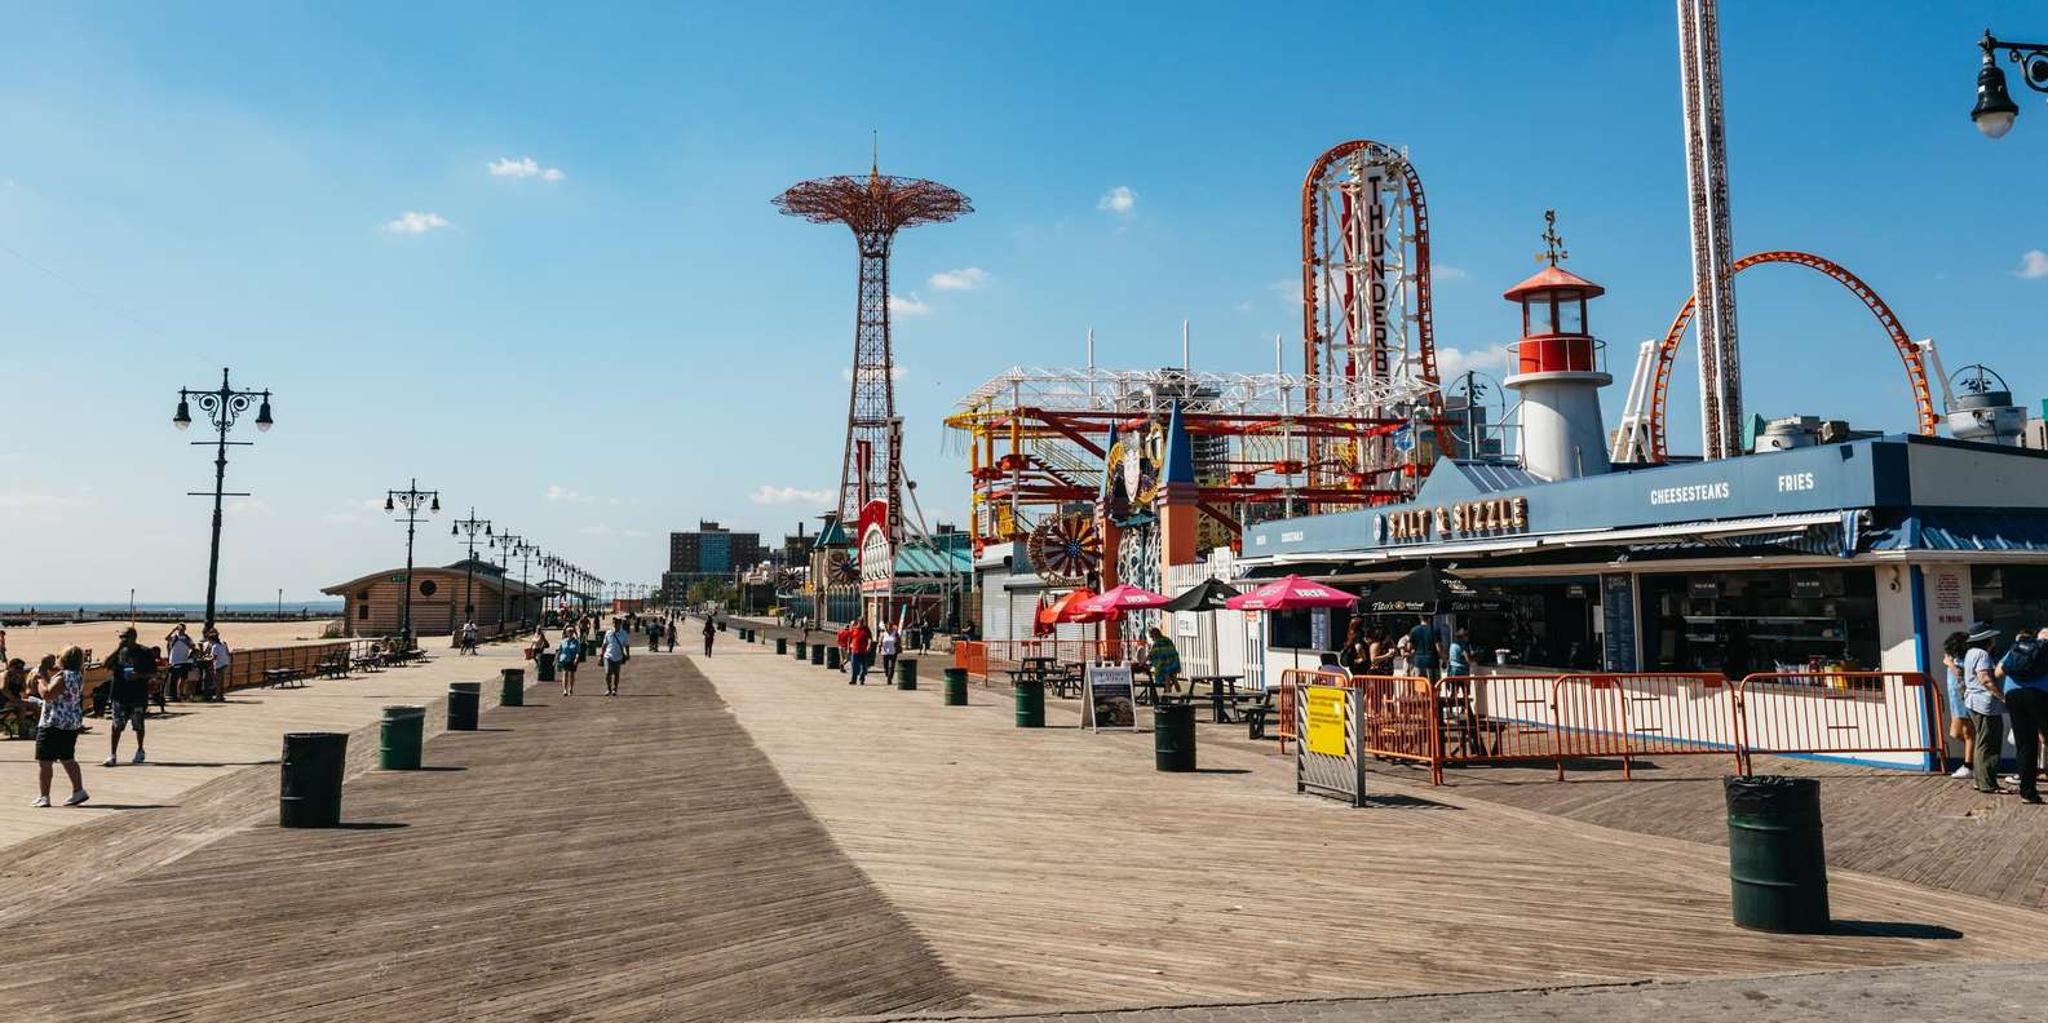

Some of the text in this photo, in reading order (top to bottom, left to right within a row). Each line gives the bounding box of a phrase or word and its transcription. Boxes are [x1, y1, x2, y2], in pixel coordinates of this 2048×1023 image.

[889, 421, 901, 555] THUNDERBOLT
[1650, 482, 1729, 505] CHEESESTEAKS
[1778, 472, 1814, 492] FRIES
[1388, 510, 1427, 537] SALT
[1435, 506, 1450, 534] &
[1454, 496, 1525, 531] SIZZLE
